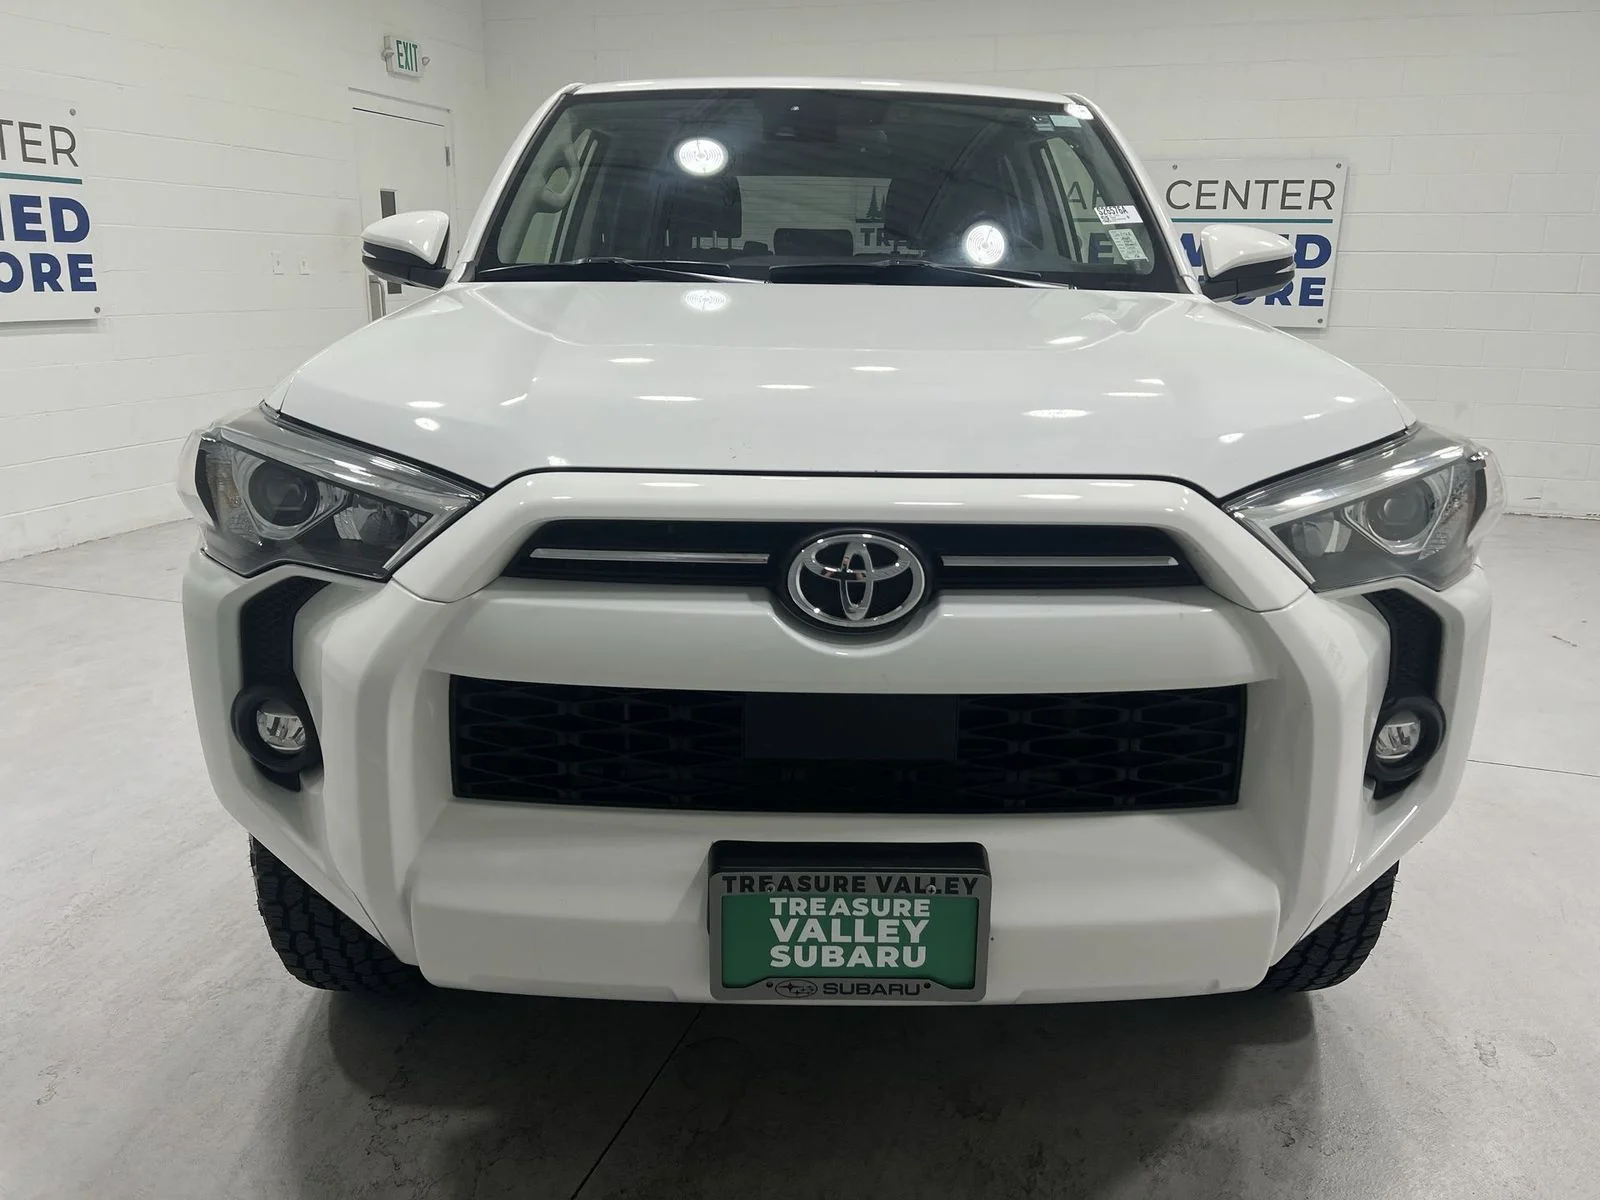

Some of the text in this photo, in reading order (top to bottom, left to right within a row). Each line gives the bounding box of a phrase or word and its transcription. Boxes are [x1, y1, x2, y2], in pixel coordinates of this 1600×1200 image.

[396, 40, 418, 72] EXIT
[1165, 179, 1336, 211] CENTER
[722, 875, 979, 895] TREASURE VALLEY
[769, 897, 931, 917] TREASURE
[769, 918, 930, 943] VALLEY
[769, 945, 927, 968] SUBARU
[823, 982, 921, 996] SUBARU
